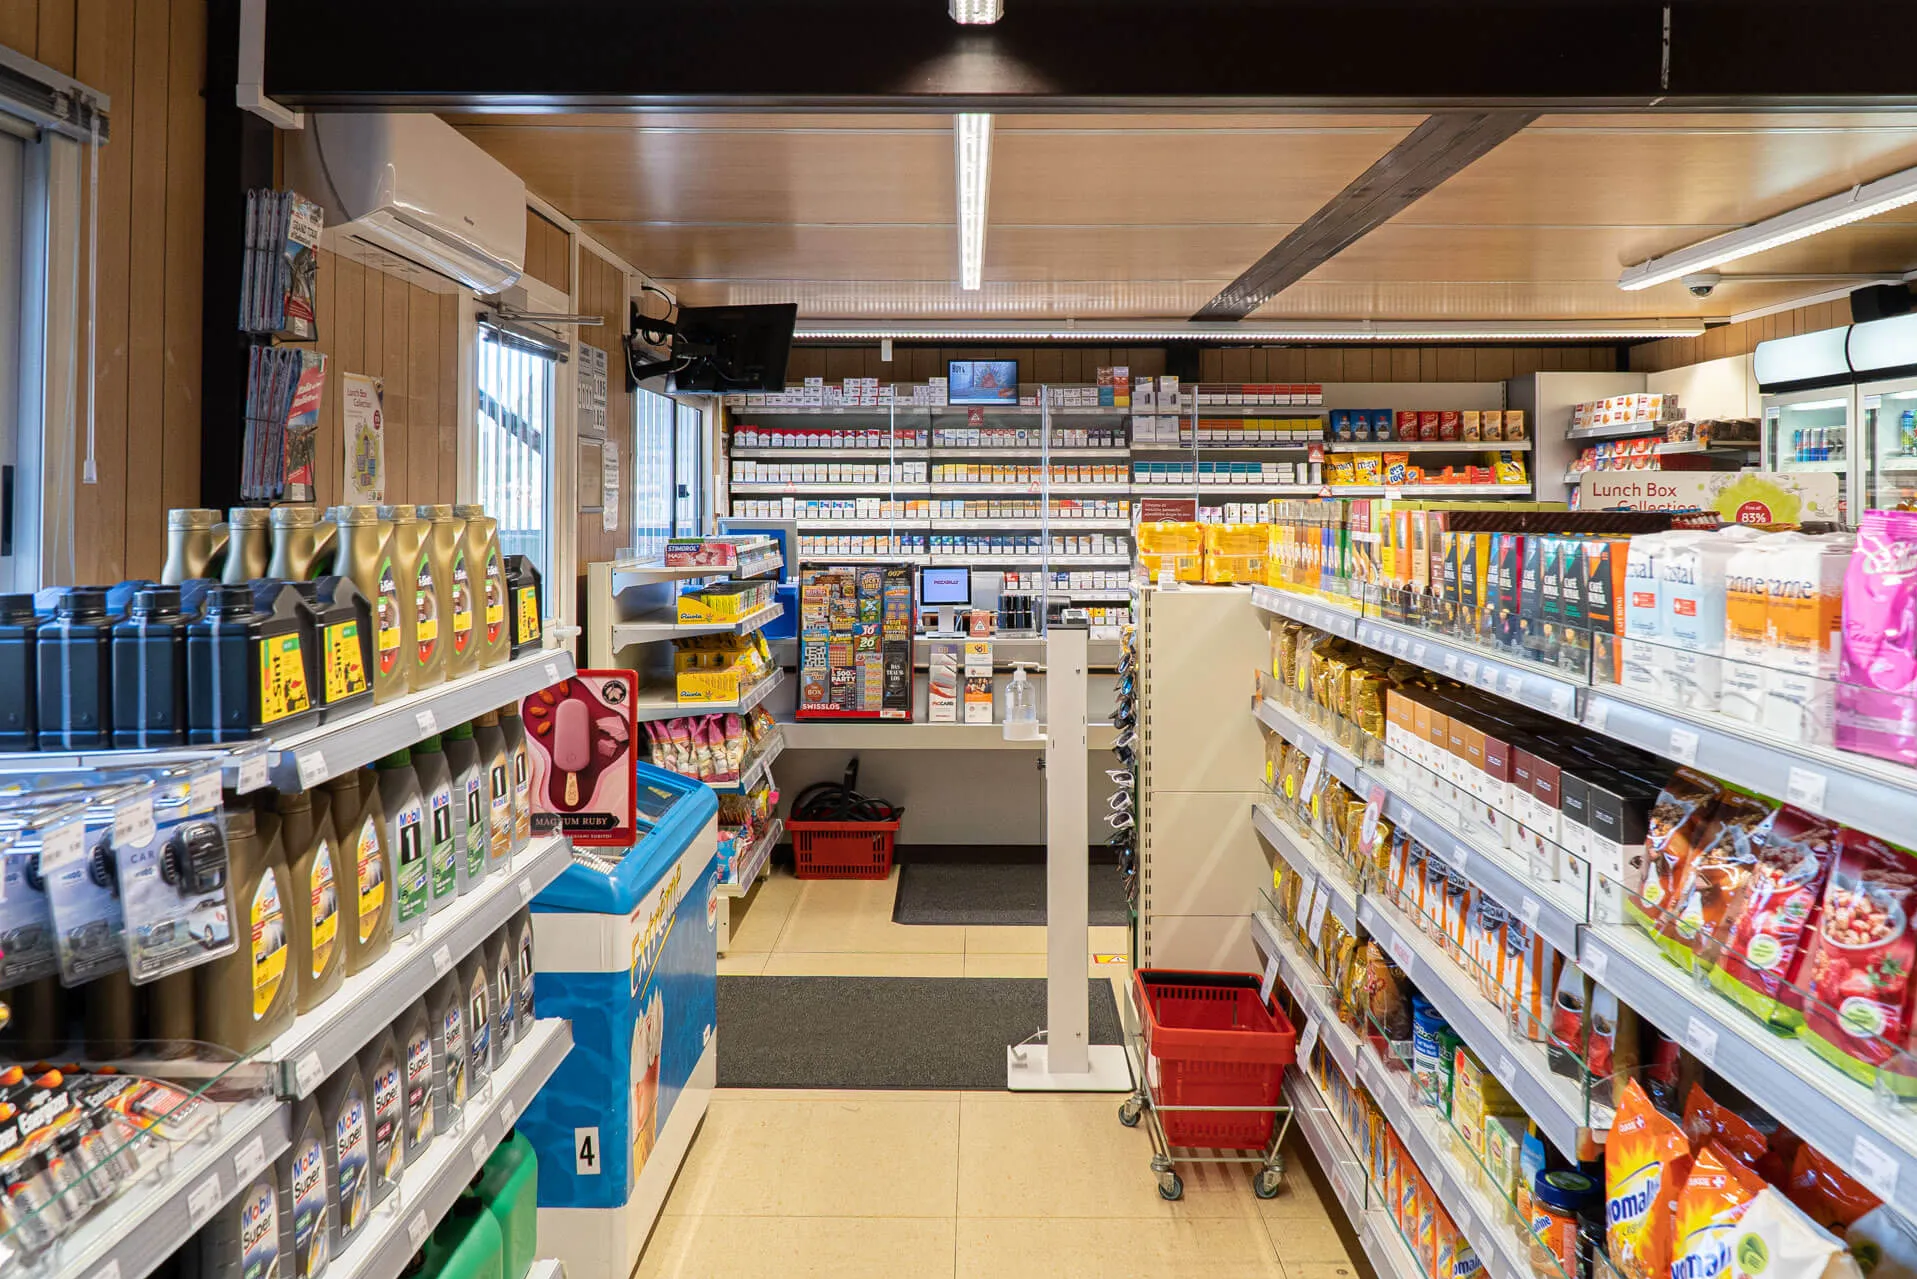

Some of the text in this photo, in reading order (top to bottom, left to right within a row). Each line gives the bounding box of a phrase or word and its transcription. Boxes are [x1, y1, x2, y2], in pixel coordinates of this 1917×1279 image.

[1593, 482, 1677, 497] Lunch Box
[1742, 512, 1766, 523] 83%
[273, 656, 282, 715] i-Sint
[831, 677, 855, 685] PARTY
[802, 703, 841, 711] SWISSLOS
[467, 776, 479, 793] Mobil
[433, 791, 449, 809] Mobil
[400, 807, 421, 827] Mobil
[582, 817, 607, 825] RUBY
[130, 853, 156, 864] CAR
[408, 1038, 428, 1061] Mobil
[409, 1054, 429, 1077] Super
[374, 1067, 398, 1096] Mobil
[375, 1085, 399, 1111] Super
[338, 1102, 361, 1138] Mobil
[339, 1125, 362, 1154] Super
[580, 1135, 595, 1167] 4
[293, 1141, 320, 1180] Mobil
[295, 1166, 320, 1200] Super
[243, 1186, 271, 1229] Mobil
[244, 1214, 271, 1250] Super
